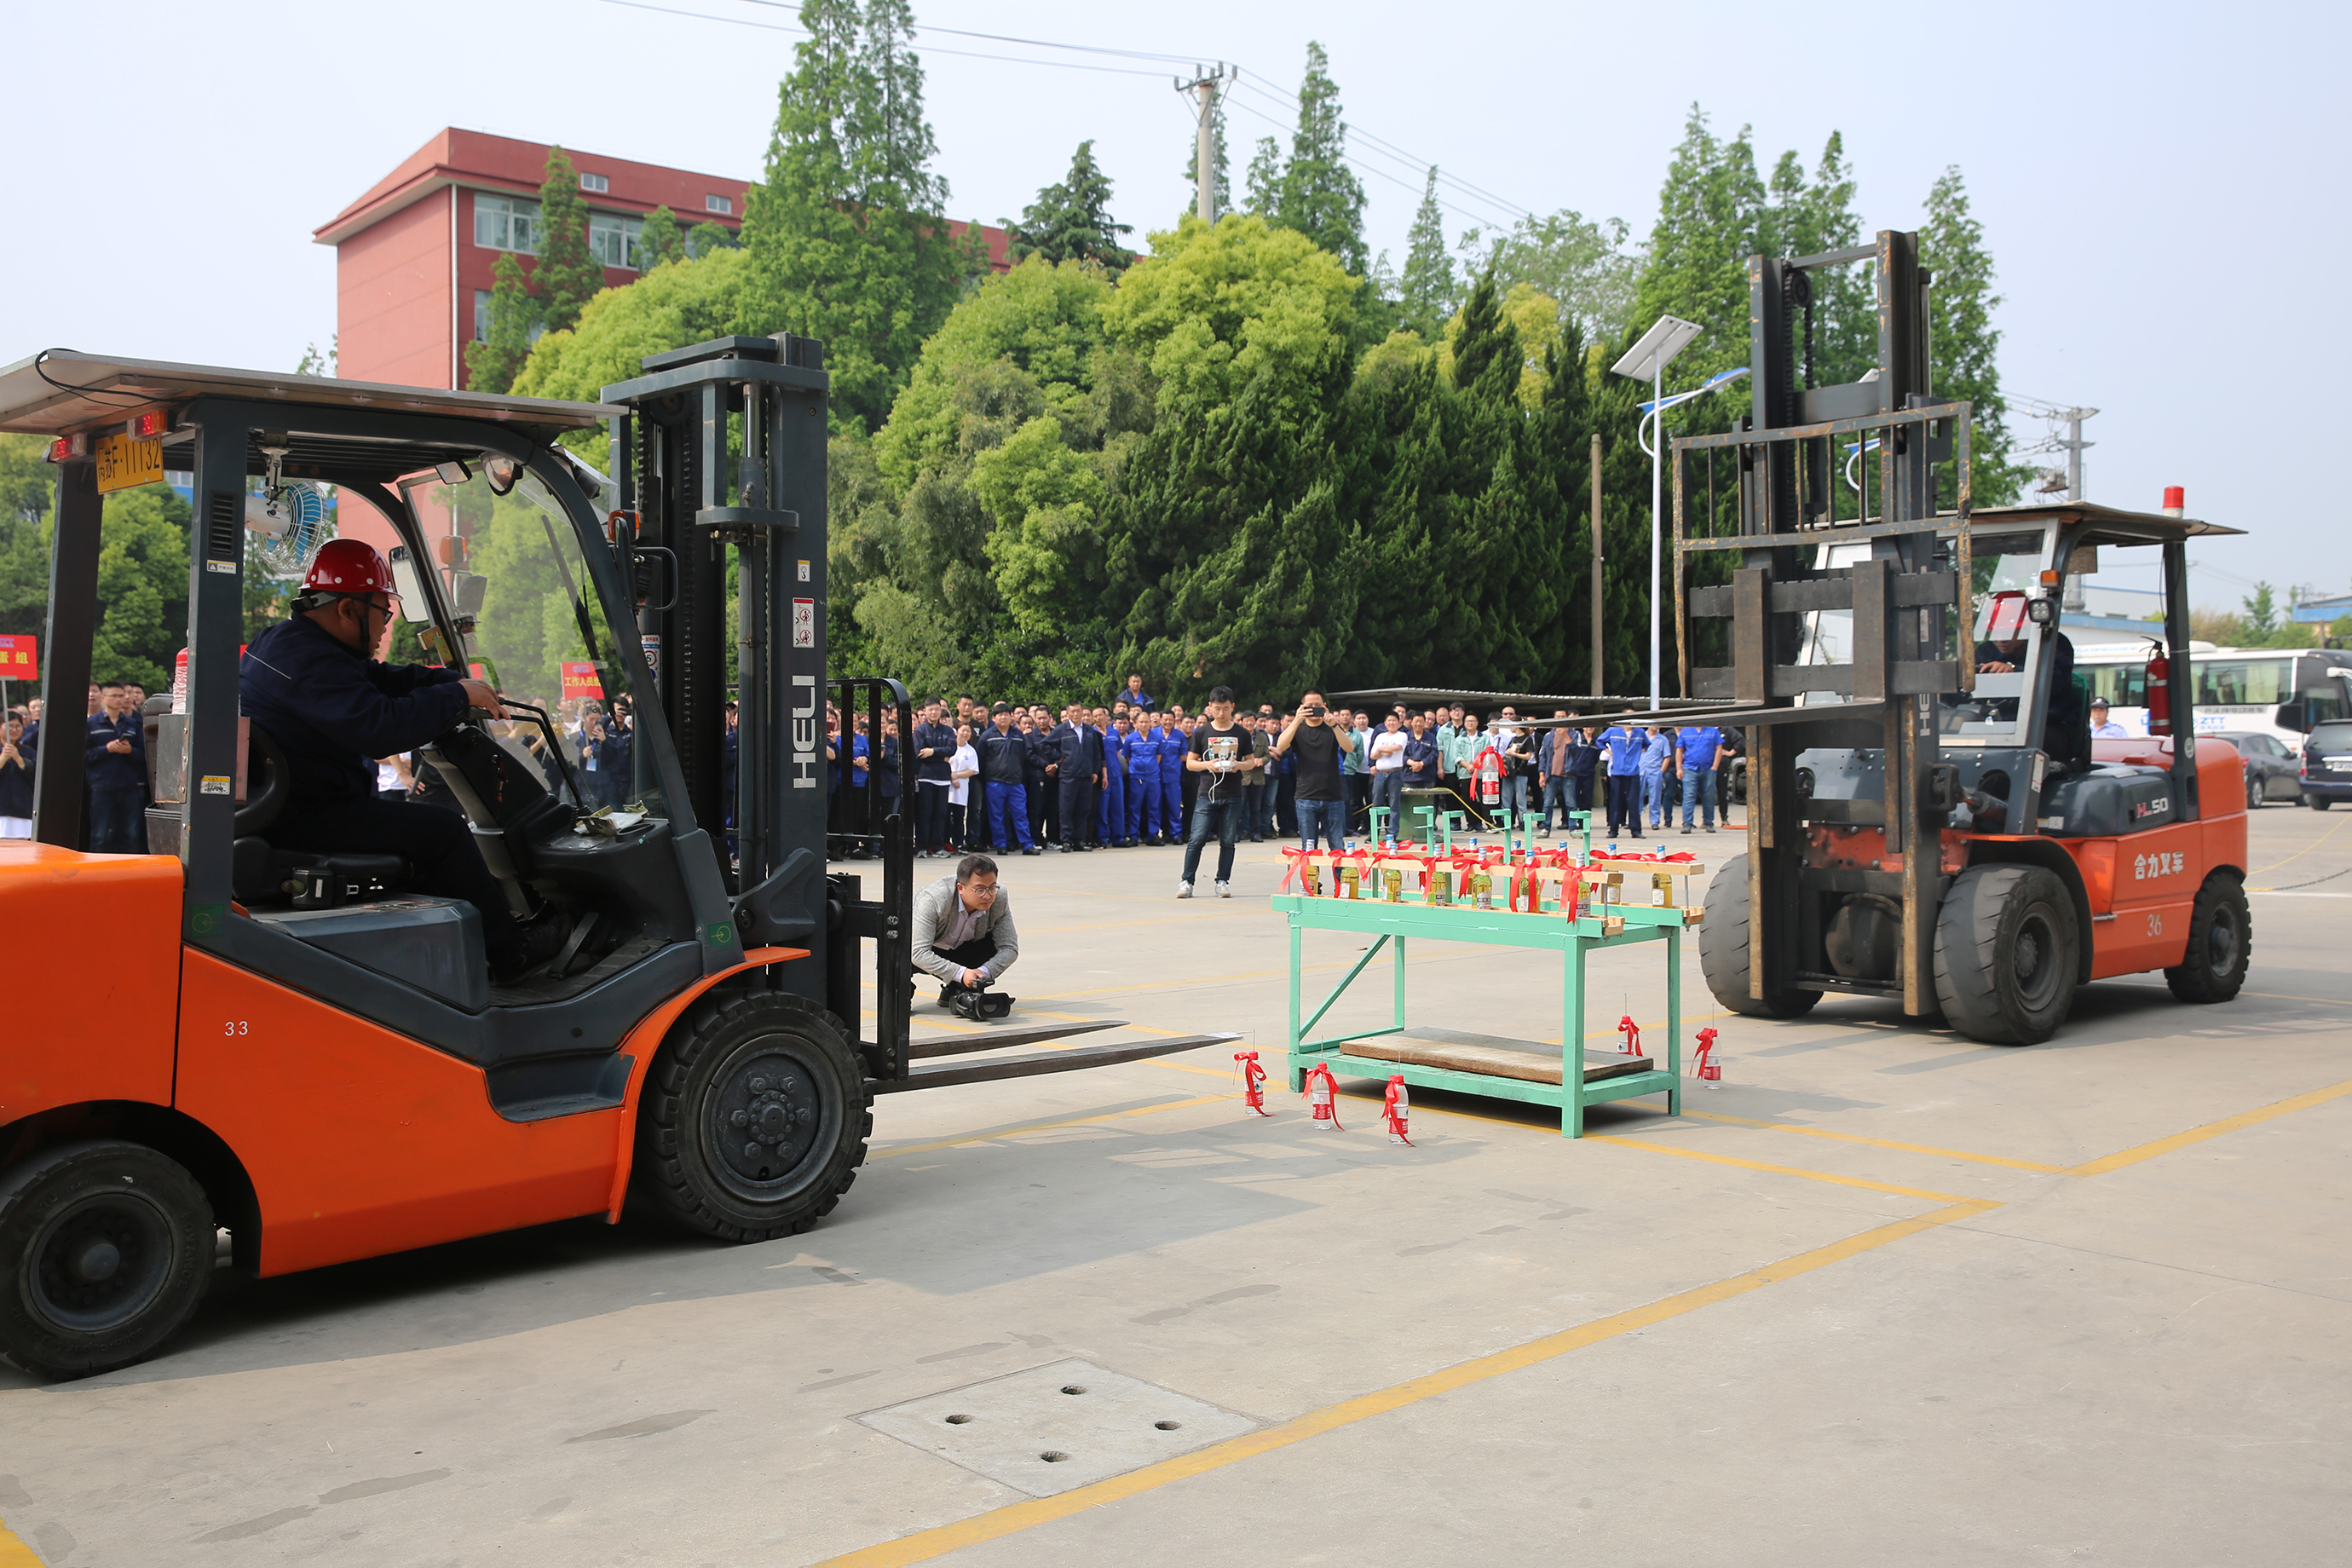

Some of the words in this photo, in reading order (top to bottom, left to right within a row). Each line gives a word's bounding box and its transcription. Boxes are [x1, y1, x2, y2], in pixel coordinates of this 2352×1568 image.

[792, 676, 816, 789] HELI
[2200, 717, 2226, 725] ZTT
[2147, 914, 2163, 937] 36
[224, 1020, 249, 1037] 33
[177, 1210, 198, 1290] ADVANCE
